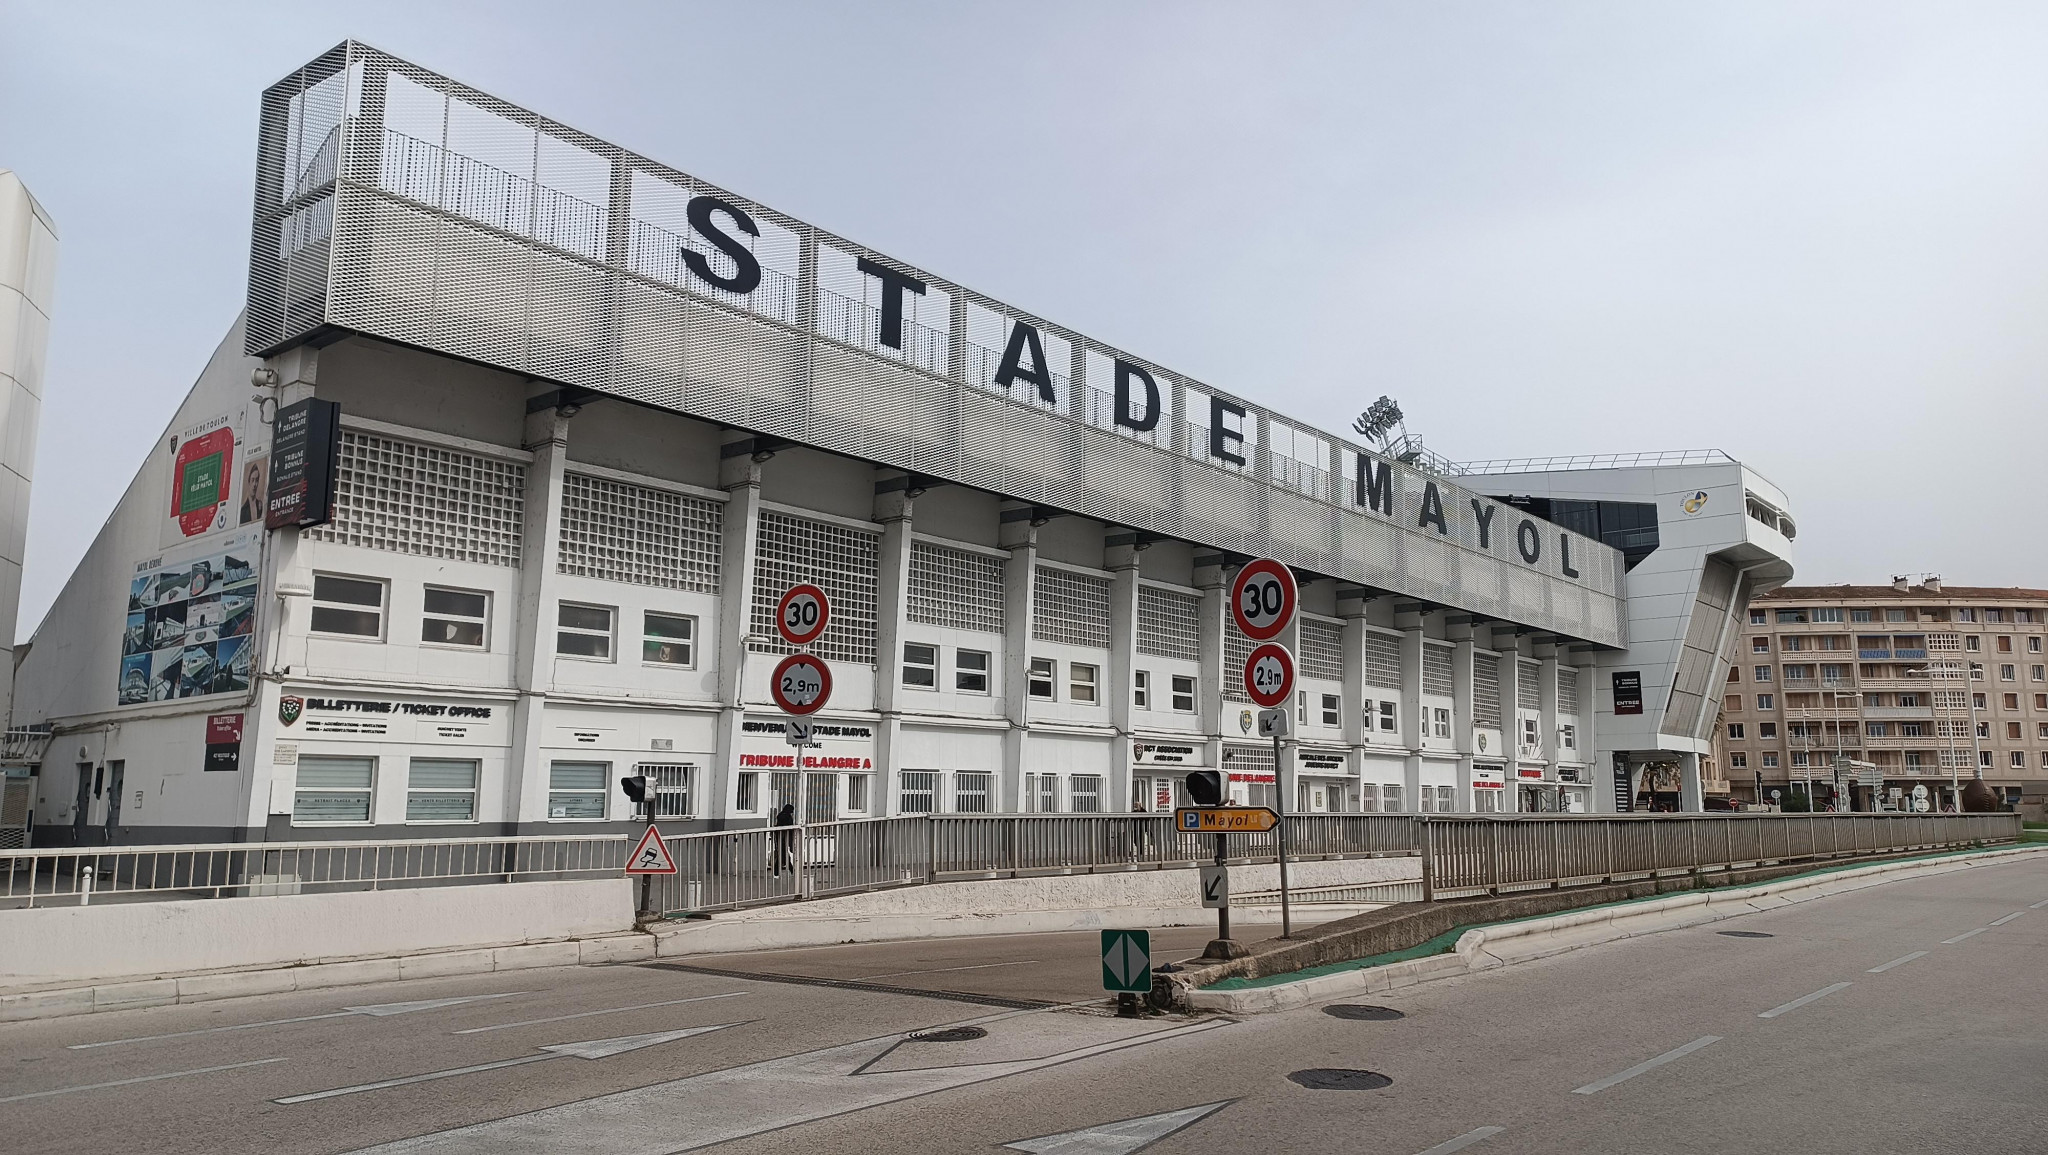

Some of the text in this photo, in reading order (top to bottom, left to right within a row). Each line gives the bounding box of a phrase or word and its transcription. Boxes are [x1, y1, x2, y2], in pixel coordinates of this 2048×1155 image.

[681, 196, 1579, 578] STADE MAYOL
[288, 409, 307, 421] TRIBUNE
[282, 417, 307, 432] DELANGRE
[284, 450, 304, 462] TRIBUNE
[284, 457, 304, 470] BONNUS
[1244, 580, 1282, 618] 30
[787, 601, 818, 627] 30
[306, 698, 392, 714] BILLETTERIE
[401, 703, 448, 717] TICKET
[447, 706, 491, 719] OFFICE
[812, 725, 841, 736] STADE
[841, 727, 872, 738] MAYOL
[739, 754, 795, 768] TRIBUNE
[862, 758, 872, 769] A
[1186, 814, 1196, 827] P
[1204, 813, 1249, 828] Mayol
